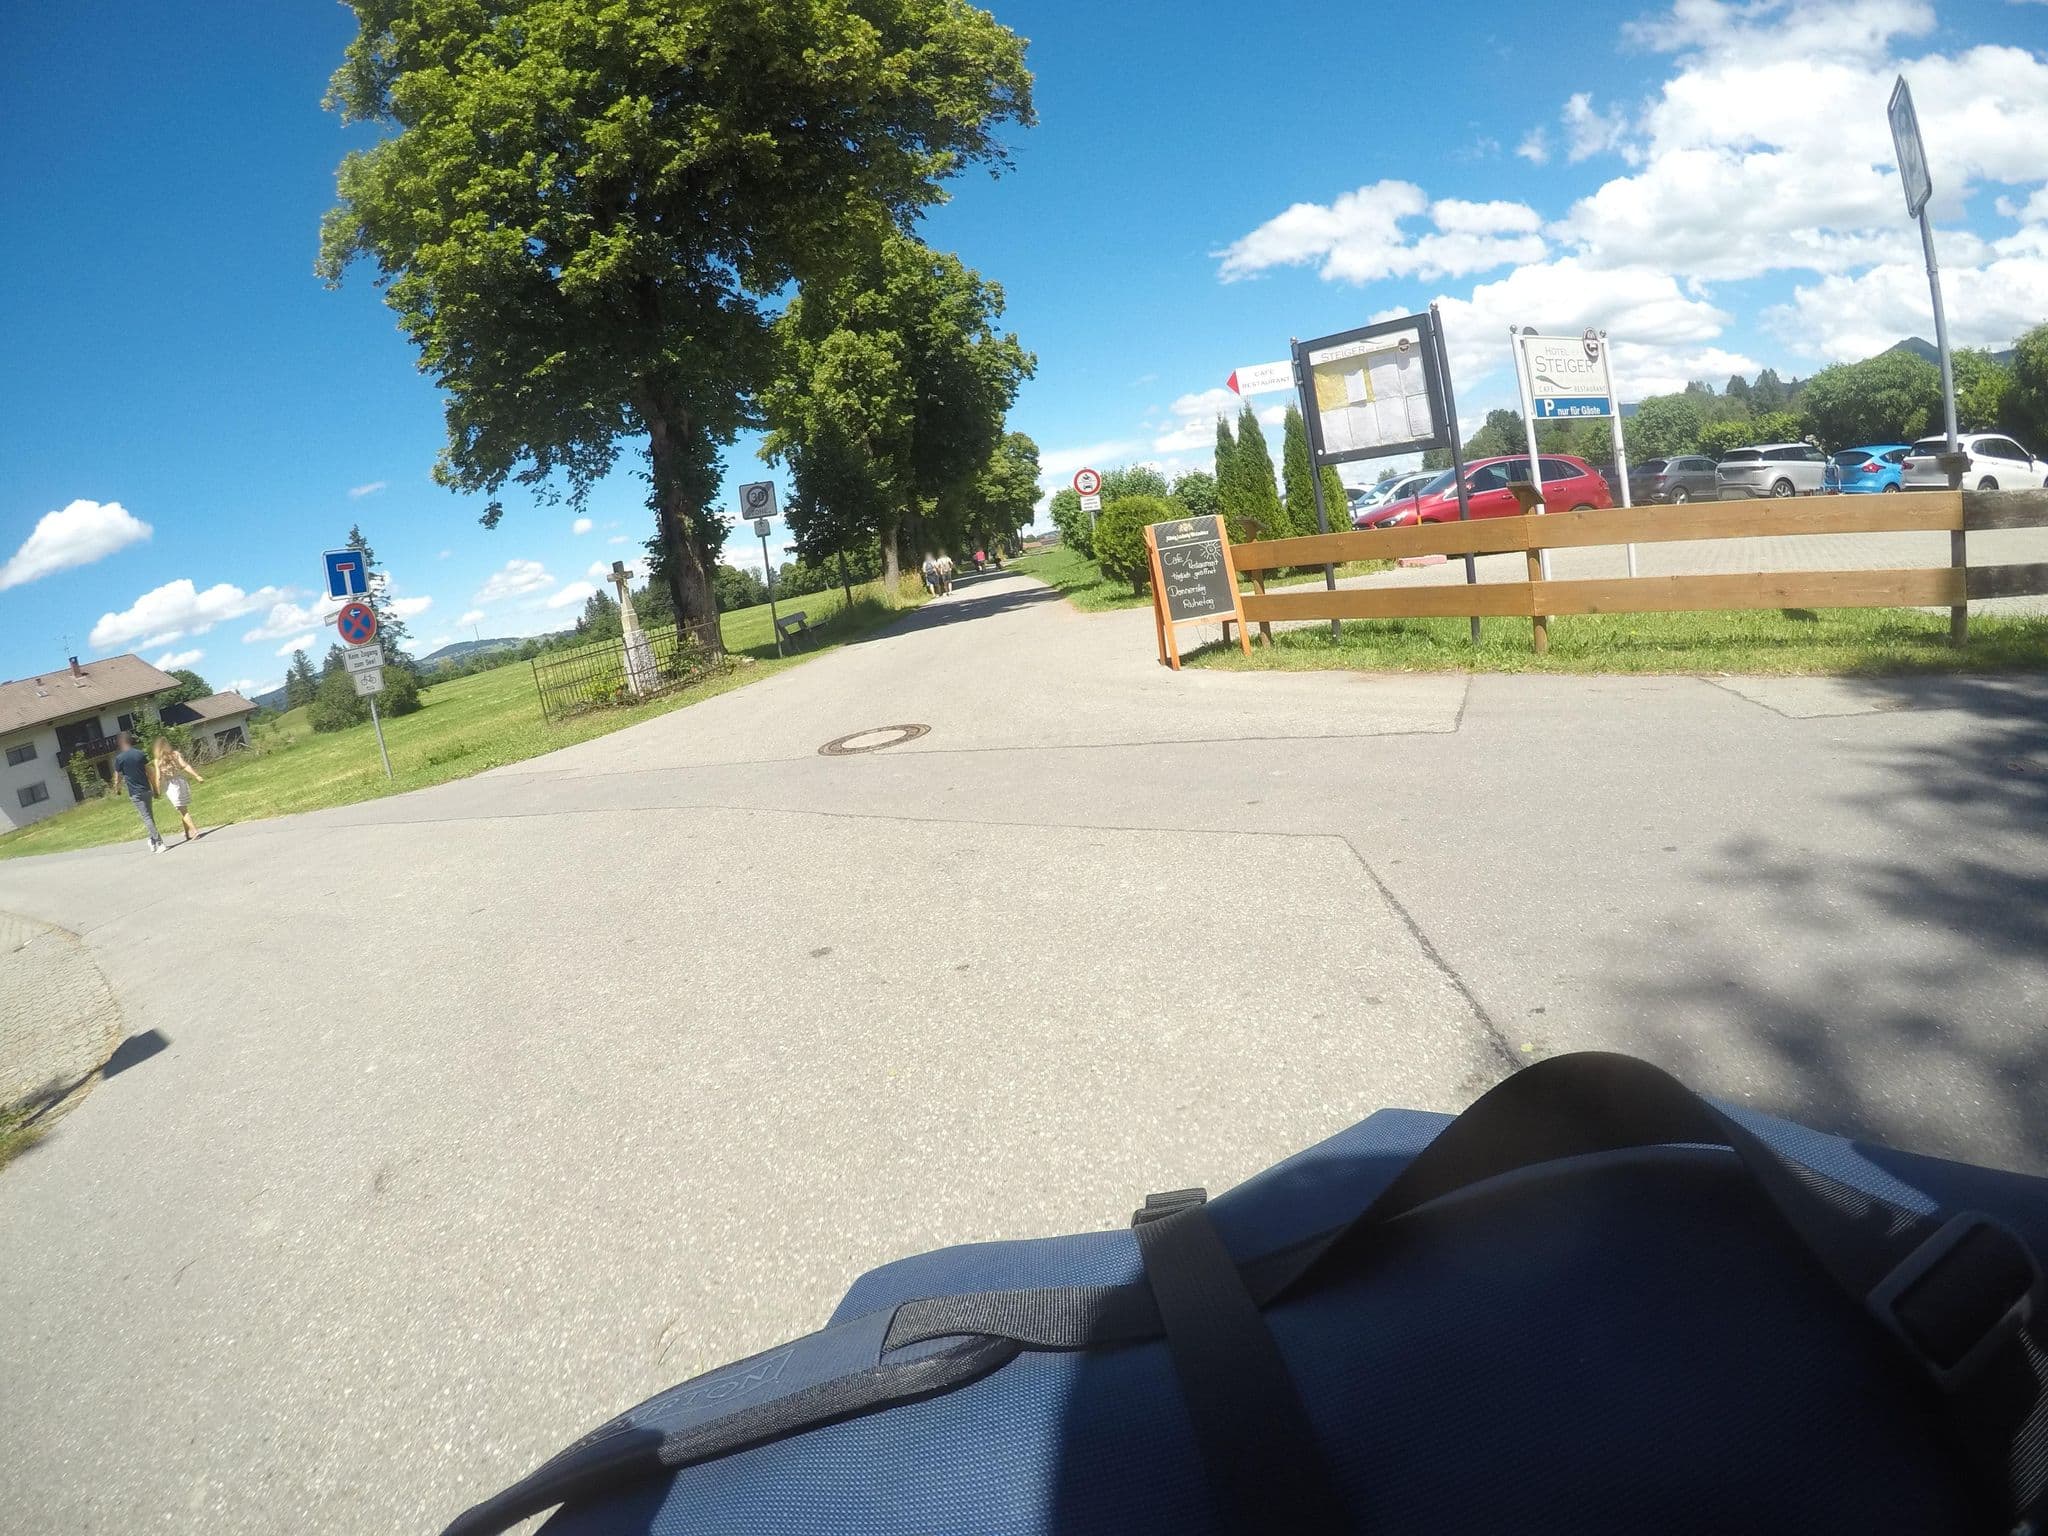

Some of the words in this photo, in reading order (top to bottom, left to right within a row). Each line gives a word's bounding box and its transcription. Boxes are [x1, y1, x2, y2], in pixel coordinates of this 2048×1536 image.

[1320, 345, 1366, 361] STEIGER
[1545, 346, 1570, 356] HOTEL
[1535, 355, 1594, 373] STEIGER
[1241, 375, 1290, 389] RESTAURANT
[1572, 384, 1606, 393] RESTAURANT
[1557, 408, 1569, 416] nur
[1570, 406, 1580, 416] für
[1581, 405, 1601, 415] Gäste
[751, 492, 765, 502] 30
[1187, 559, 1219, 569] Restaurant
[1182, 596, 1215, 609] Ruhetag
